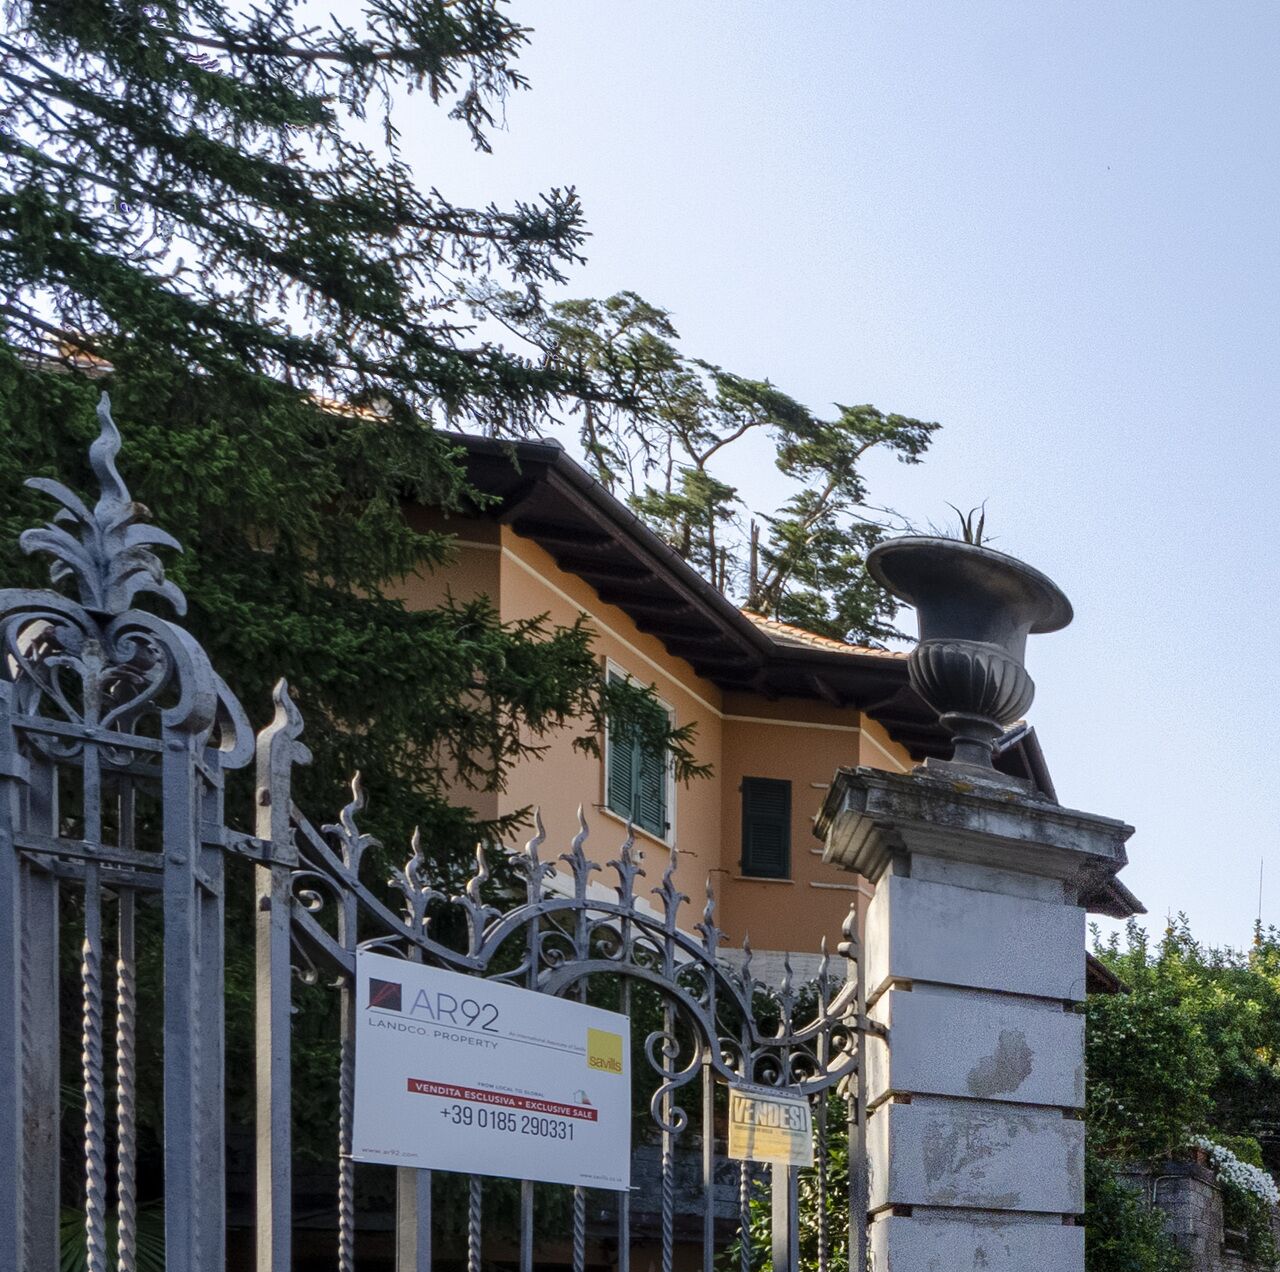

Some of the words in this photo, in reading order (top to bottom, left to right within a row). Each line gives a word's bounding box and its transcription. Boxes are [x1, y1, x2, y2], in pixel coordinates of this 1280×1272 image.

[409, 988, 499, 1033] AR92
[367, 1017, 430, 1037] LANDCO.
[433, 1030, 499, 1050] PROPERTY
[589, 1056, 622, 1073] savills
[415, 1082, 461, 1098] VENDITA
[464, 1090, 516, 1107] ESCLUSIVA
[525, 1100, 572, 1116] EXCLUSIVE
[573, 1109, 593, 1120] SALE
[733, 1096, 807, 1132] VENDESI
[440, 1104, 473, 1126] +39
[478, 1108, 517, 1133] 0185
[521, 1115, 574, 1141] 290331
